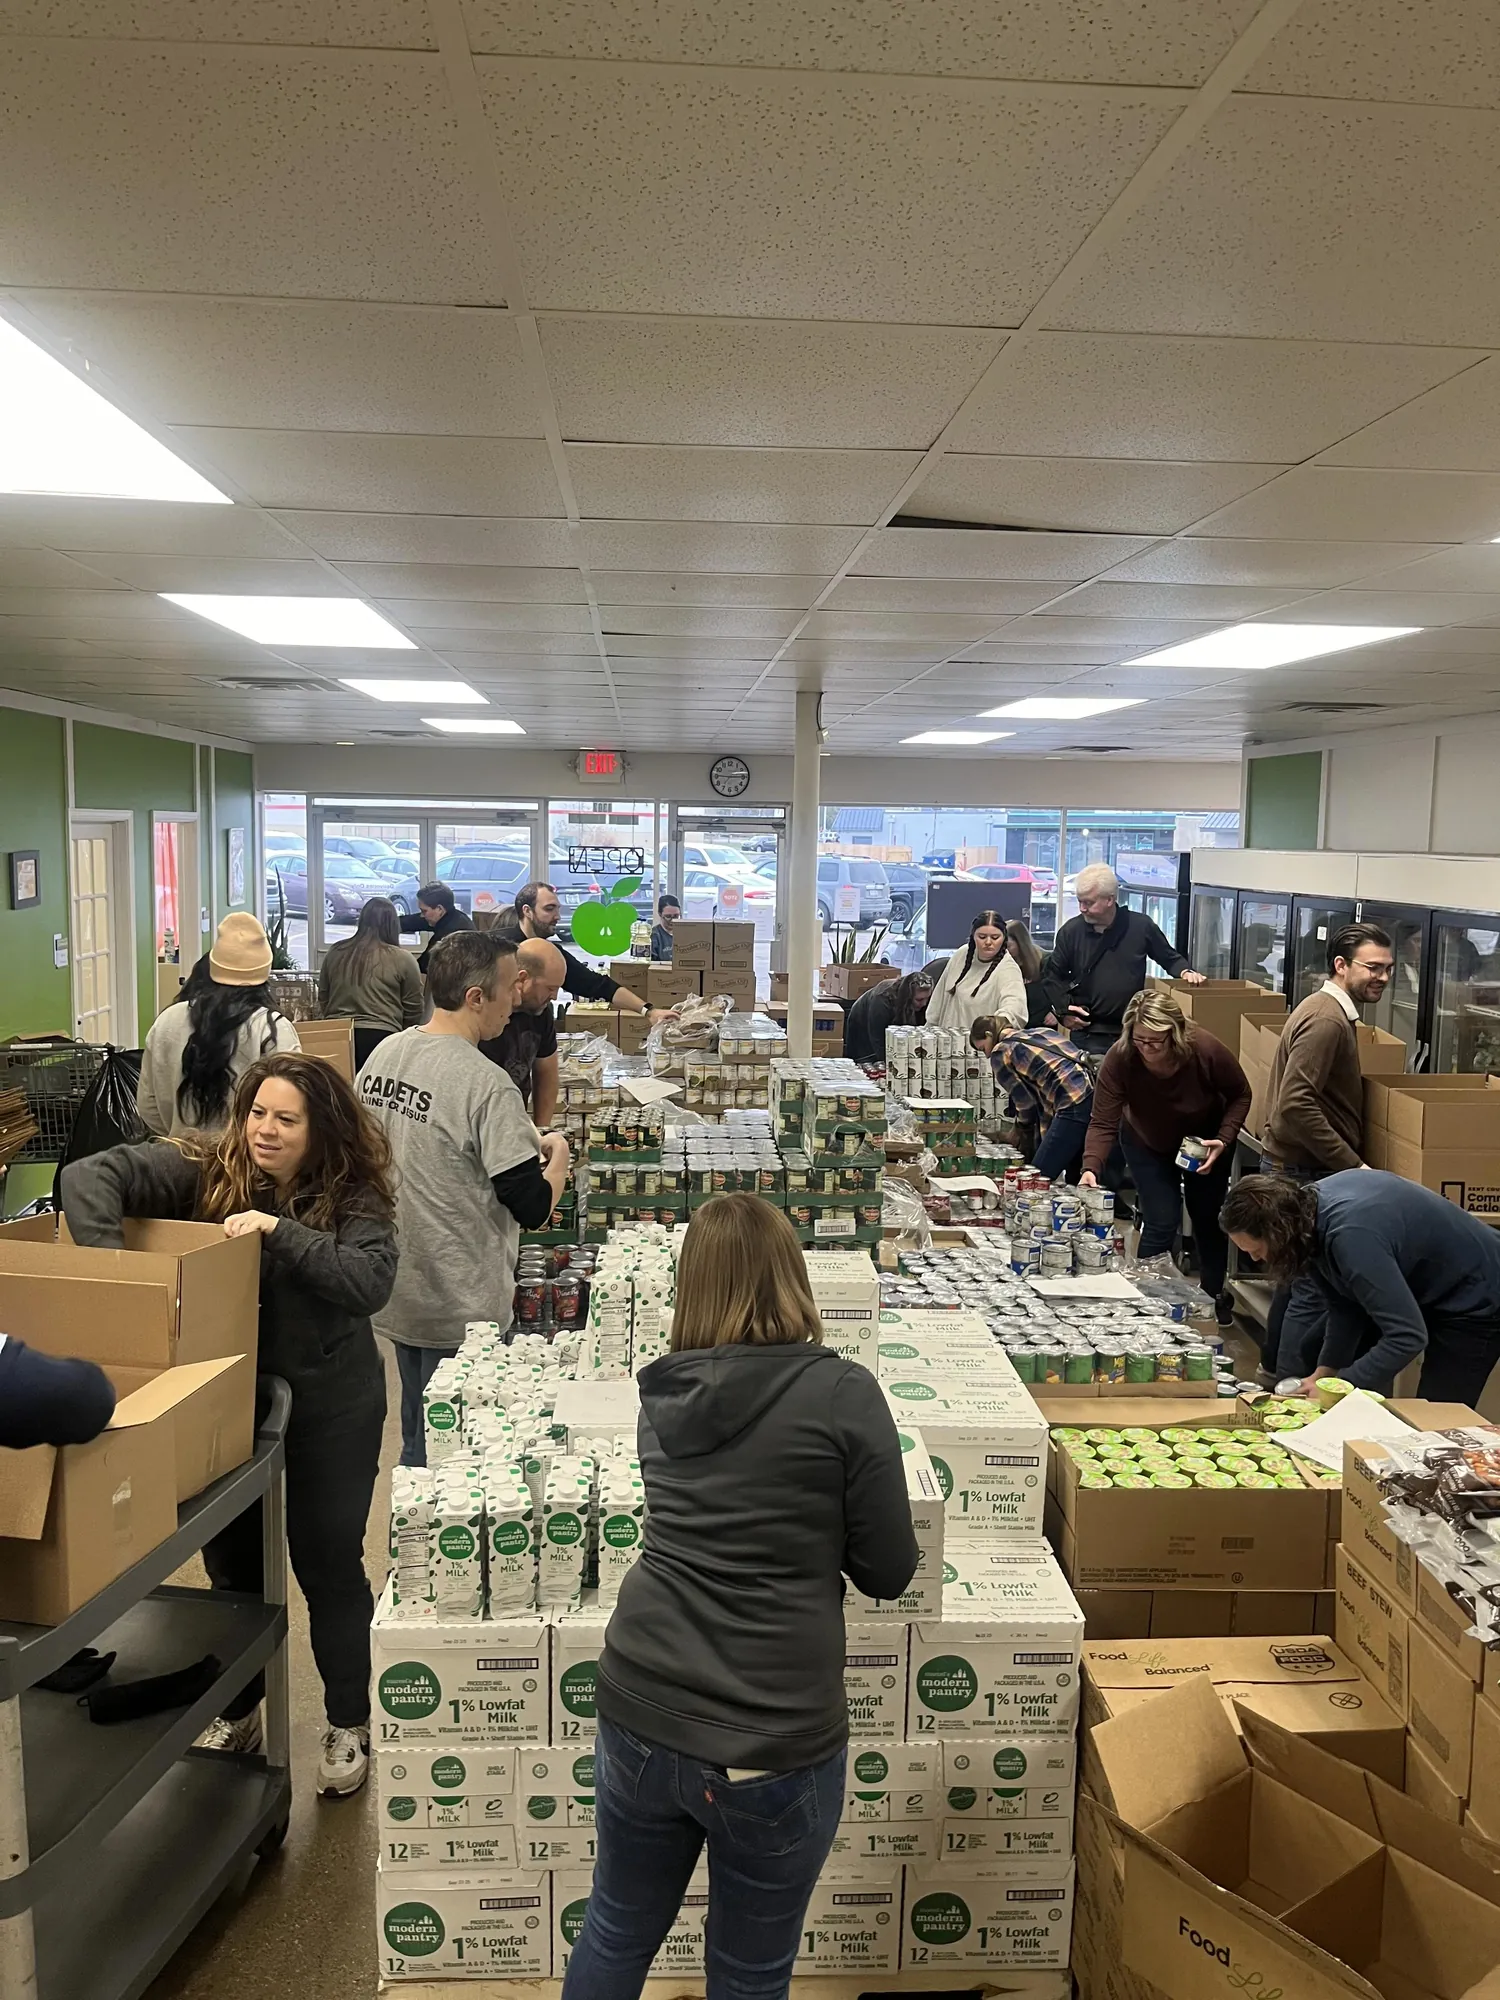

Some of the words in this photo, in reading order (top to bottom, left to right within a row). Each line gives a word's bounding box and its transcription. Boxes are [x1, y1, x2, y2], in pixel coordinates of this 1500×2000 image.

[586, 753, 615, 774] EXIT
[363, 1075, 432, 1112] CADETS
[401, 1106, 428, 1123] JESUS
[1468, 1203, 1500, 1212] Actio
[1354, 1457, 1374, 1482] BEEF
[959, 1490, 982, 1512] 1%
[986, 1492, 1026, 1502] Lowfat
[1346, 1487, 1361, 1509] Food
[993, 1504, 1018, 1513] Milk
[496, 1534, 525, 1542] modern
[1365, 1528, 1392, 1562] Balanced
[505, 1557, 517, 1565] 1%
[446, 1569, 469, 1577] MILK
[501, 1564, 524, 1573] MILK
[959, 1582, 987, 1596] 1%
[1347, 1562, 1367, 1590] BEEF
[1370, 1587, 1393, 1619] STEW
[1089, 1652, 1128, 1661] Food
[1128, 1652, 1168, 1668] Life
[1145, 1664, 1210, 1675] Balanced
[922, 1678, 970, 1686] modern
[383, 1685, 433, 1694] modern
[928, 1688, 972, 1698] pantry
[391, 1695, 436, 1705] pantry
[847, 1695, 883, 1706] owfat
[984, 1693, 1009, 1716] 1%
[1014, 1693, 1058, 1704] Lowfat
[449, 1699, 475, 1723] 1%
[480, 1699, 525, 1710] Lowfat
[848, 1708, 875, 1719] Milk
[1021, 1706, 1049, 1717] Milk
[488, 1712, 517, 1723] Milk
[917, 1715, 935, 1729] 12
[380, 1723, 399, 1738] 12
[561, 1721, 580, 1736] 12
[863, 1803, 876, 1811] 1%
[1001, 1799, 1013, 1807] 1%
[442, 1807, 454, 1815] 1%
[858, 1810, 881, 1818] MILK
[996, 1806, 1019, 1814] MILK
[437, 1814, 460, 1822] MILK
[868, 1835, 885, 1851] 1%
[888, 1835, 918, 1843] Lowfat
[947, 1833, 966, 1848] 12
[1003, 1832, 1021, 1848] 1%
[1023, 1832, 1053, 1840] Lowfat
[1028, 1840, 1048, 1848] Milk
[388, 1843, 408, 1858] 12
[446, 1841, 464, 1857] 1%
[467, 1840, 499, 1849] Lowfat
[529, 1842, 549, 1857] 12
[893, 1843, 913, 1851] Milk
[389, 1924, 437, 1933] modern
[923, 1923, 965, 1932] pantry
[397, 1934, 440, 1943] pantry
[804, 1931, 829, 1952] 1%
[834, 1931, 878, 1941] Lowfat
[977, 1927, 1002, 1948] 1%
[1006, 1927, 1049, 1937] Lowfat
[1179, 1916, 1230, 1967] Food
[452, 1937, 478, 1959] 1%
[482, 1935, 528, 1947] Lowfat
[841, 1943, 869, 1952] Milk
[1013, 1939, 1040, 1948] Milk
[491, 1948, 520, 1958] Milk
[667, 1945, 694, 1955] Milk
[910, 1948, 928, 1960] 12
[387, 1958, 405, 1972] 12
